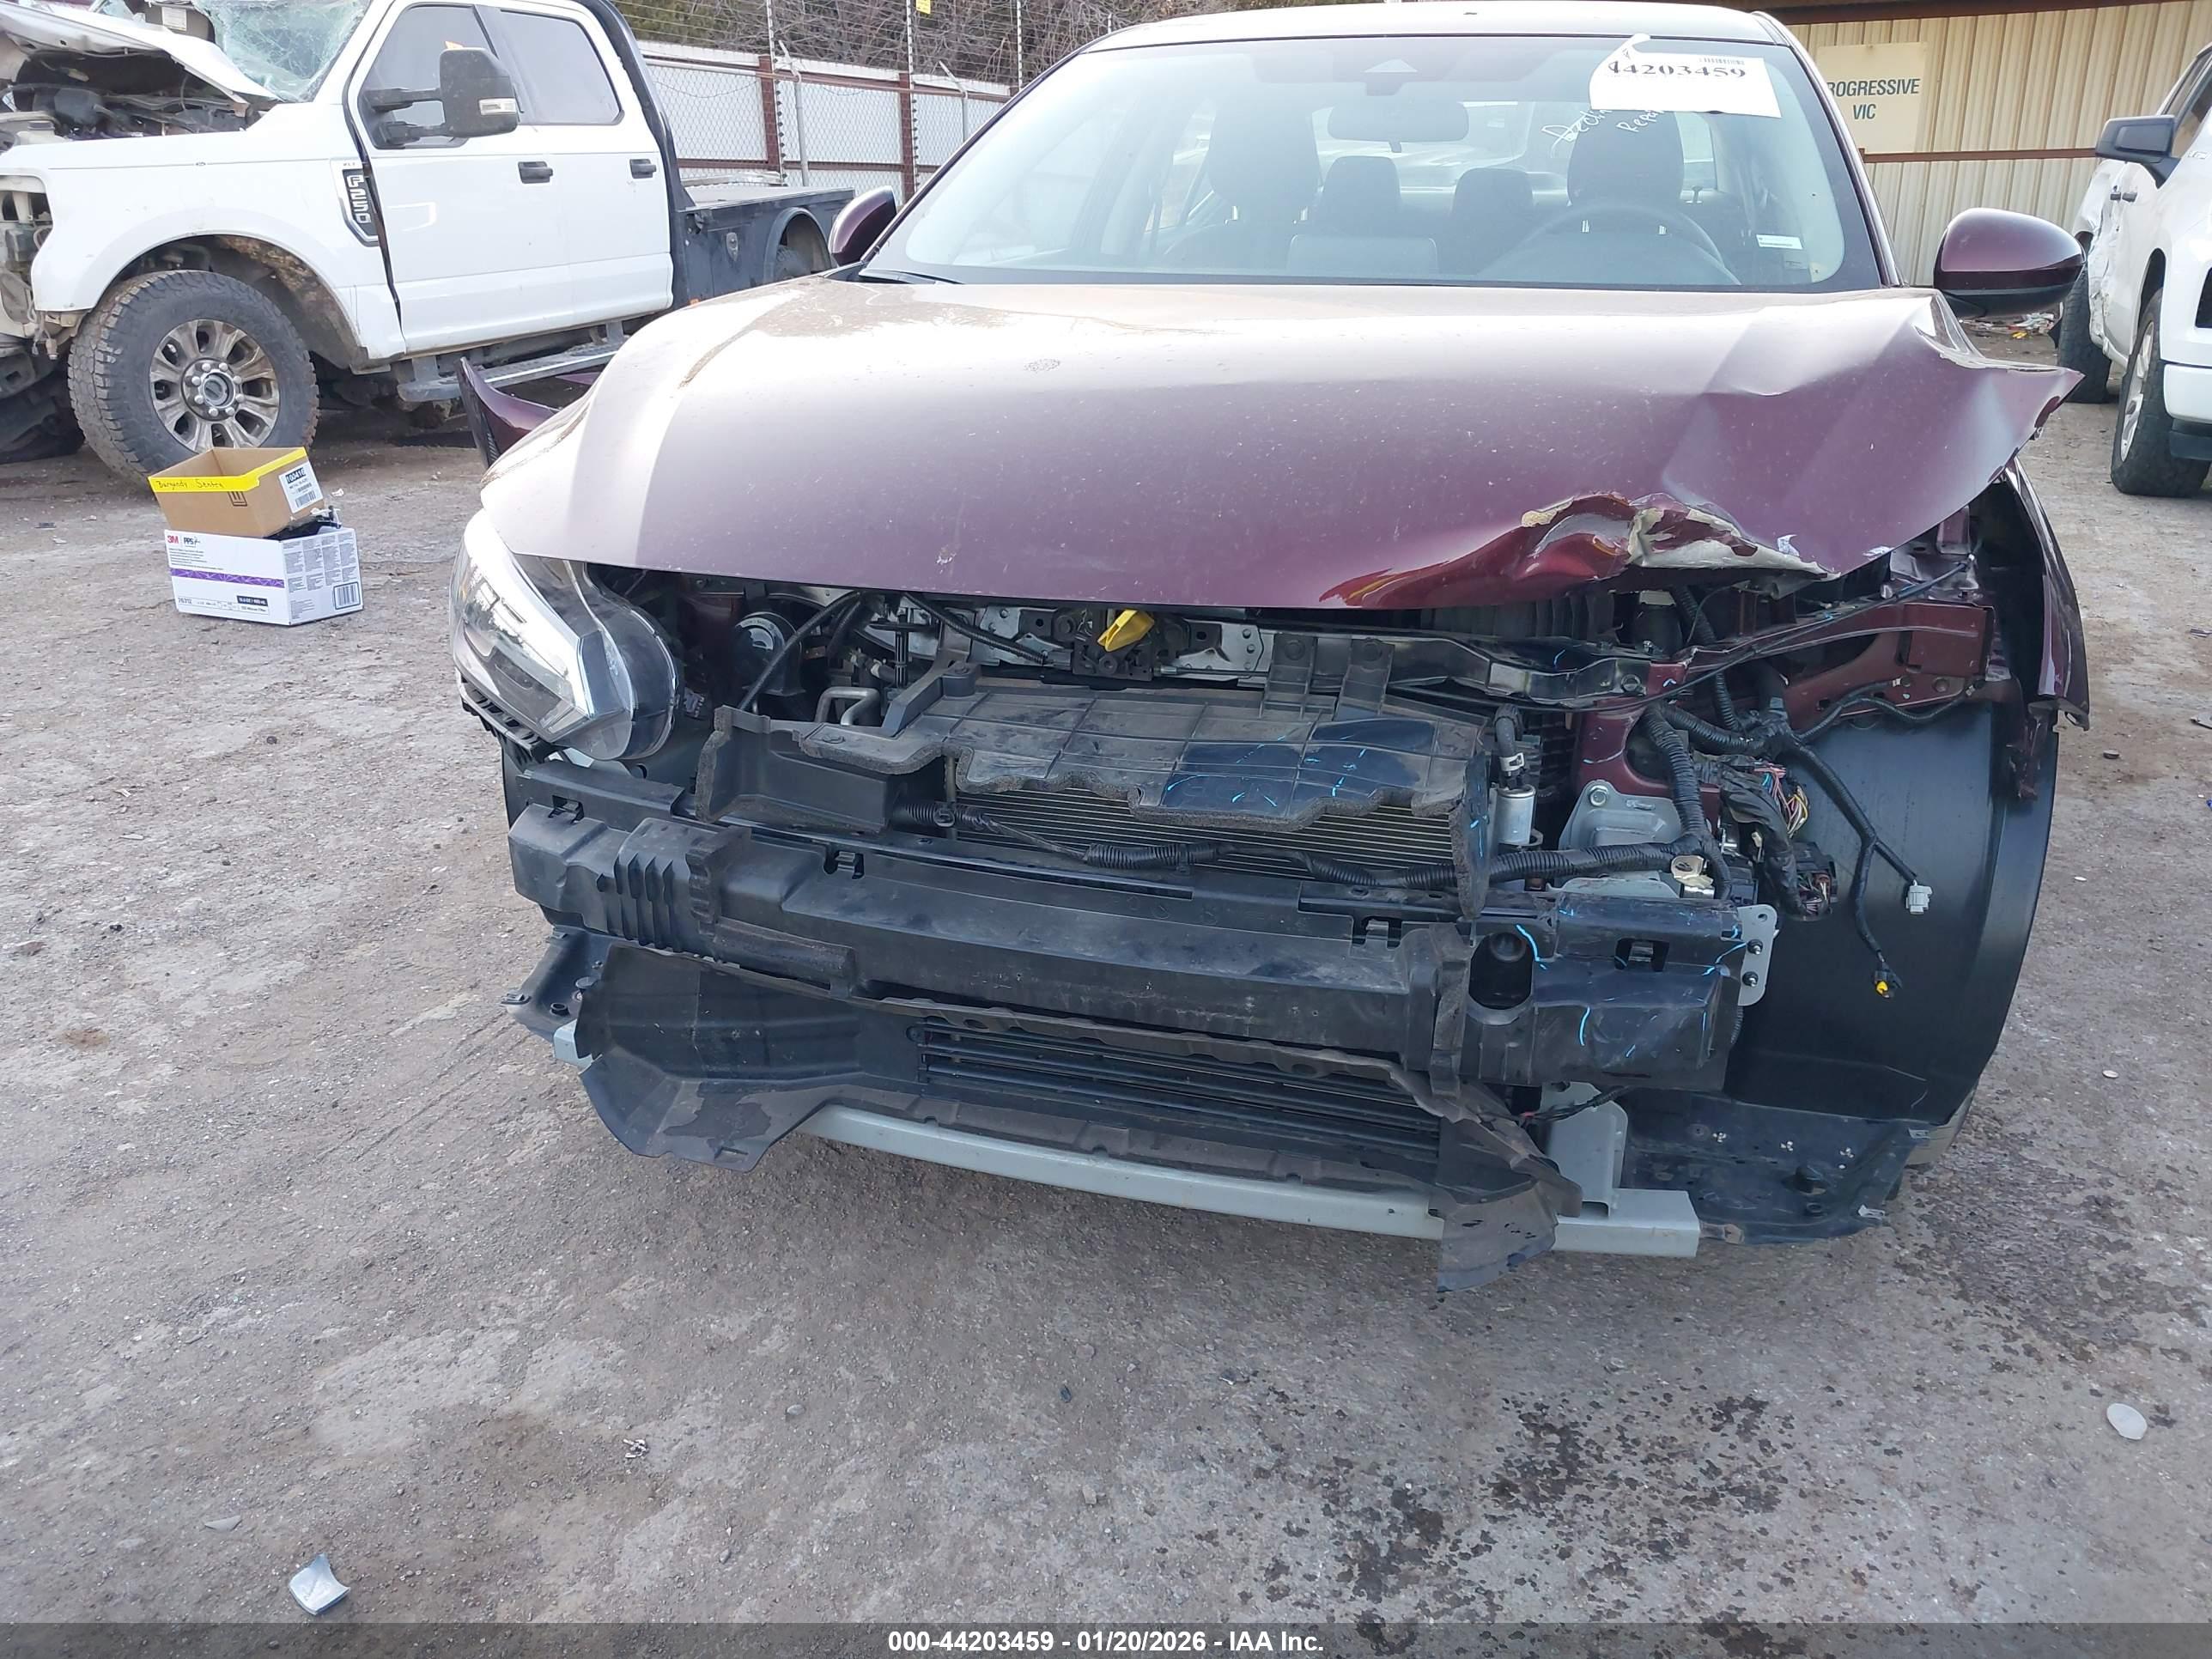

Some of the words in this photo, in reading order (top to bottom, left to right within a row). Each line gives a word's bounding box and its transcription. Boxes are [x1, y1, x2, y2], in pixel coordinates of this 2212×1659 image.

[1607, 60, 1746, 78] 44203459
[1826, 78, 1921, 97] ROGRESSIVE
[1853, 103, 1876, 120] VIC
[346, 174, 372, 224] F250
[167, 535, 179, 544] 3M
